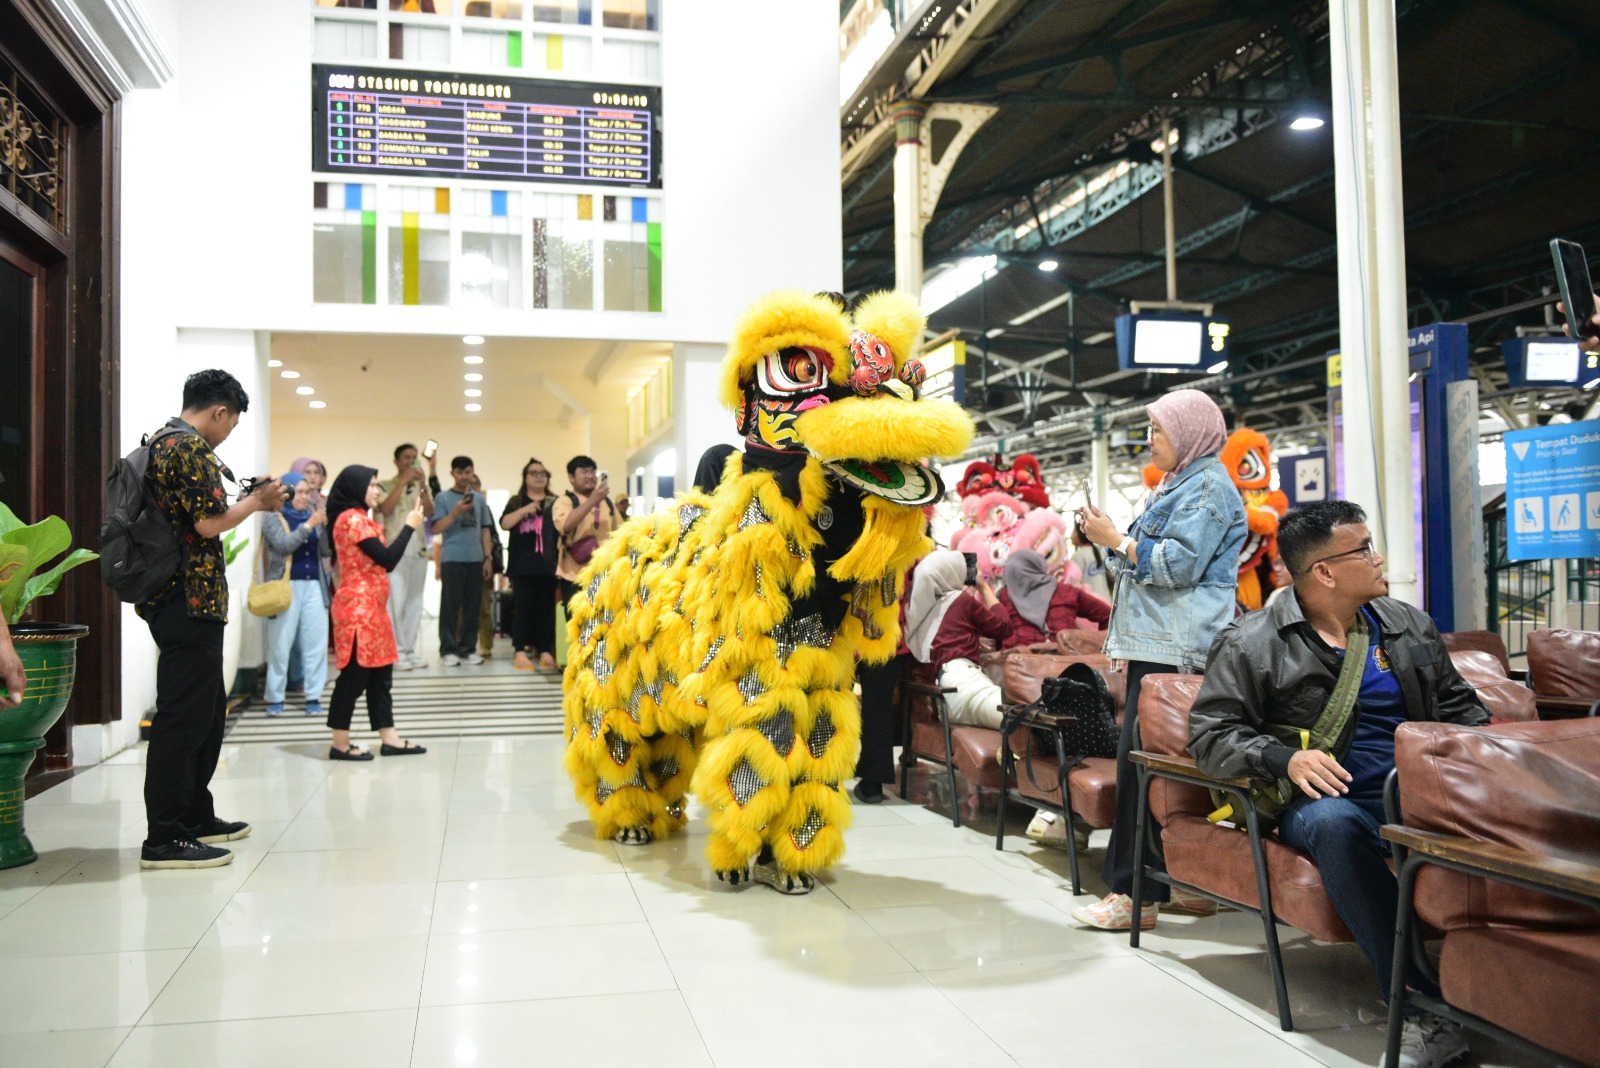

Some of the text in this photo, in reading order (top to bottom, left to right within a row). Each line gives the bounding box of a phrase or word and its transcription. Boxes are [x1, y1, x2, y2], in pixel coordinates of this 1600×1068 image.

[358, 75, 418, 92] STASIUN
[424, 80, 511, 98] YOGYAKARTA
[1418, 329, 1434, 346] Api
[1534, 437, 1568, 449] Tempat
